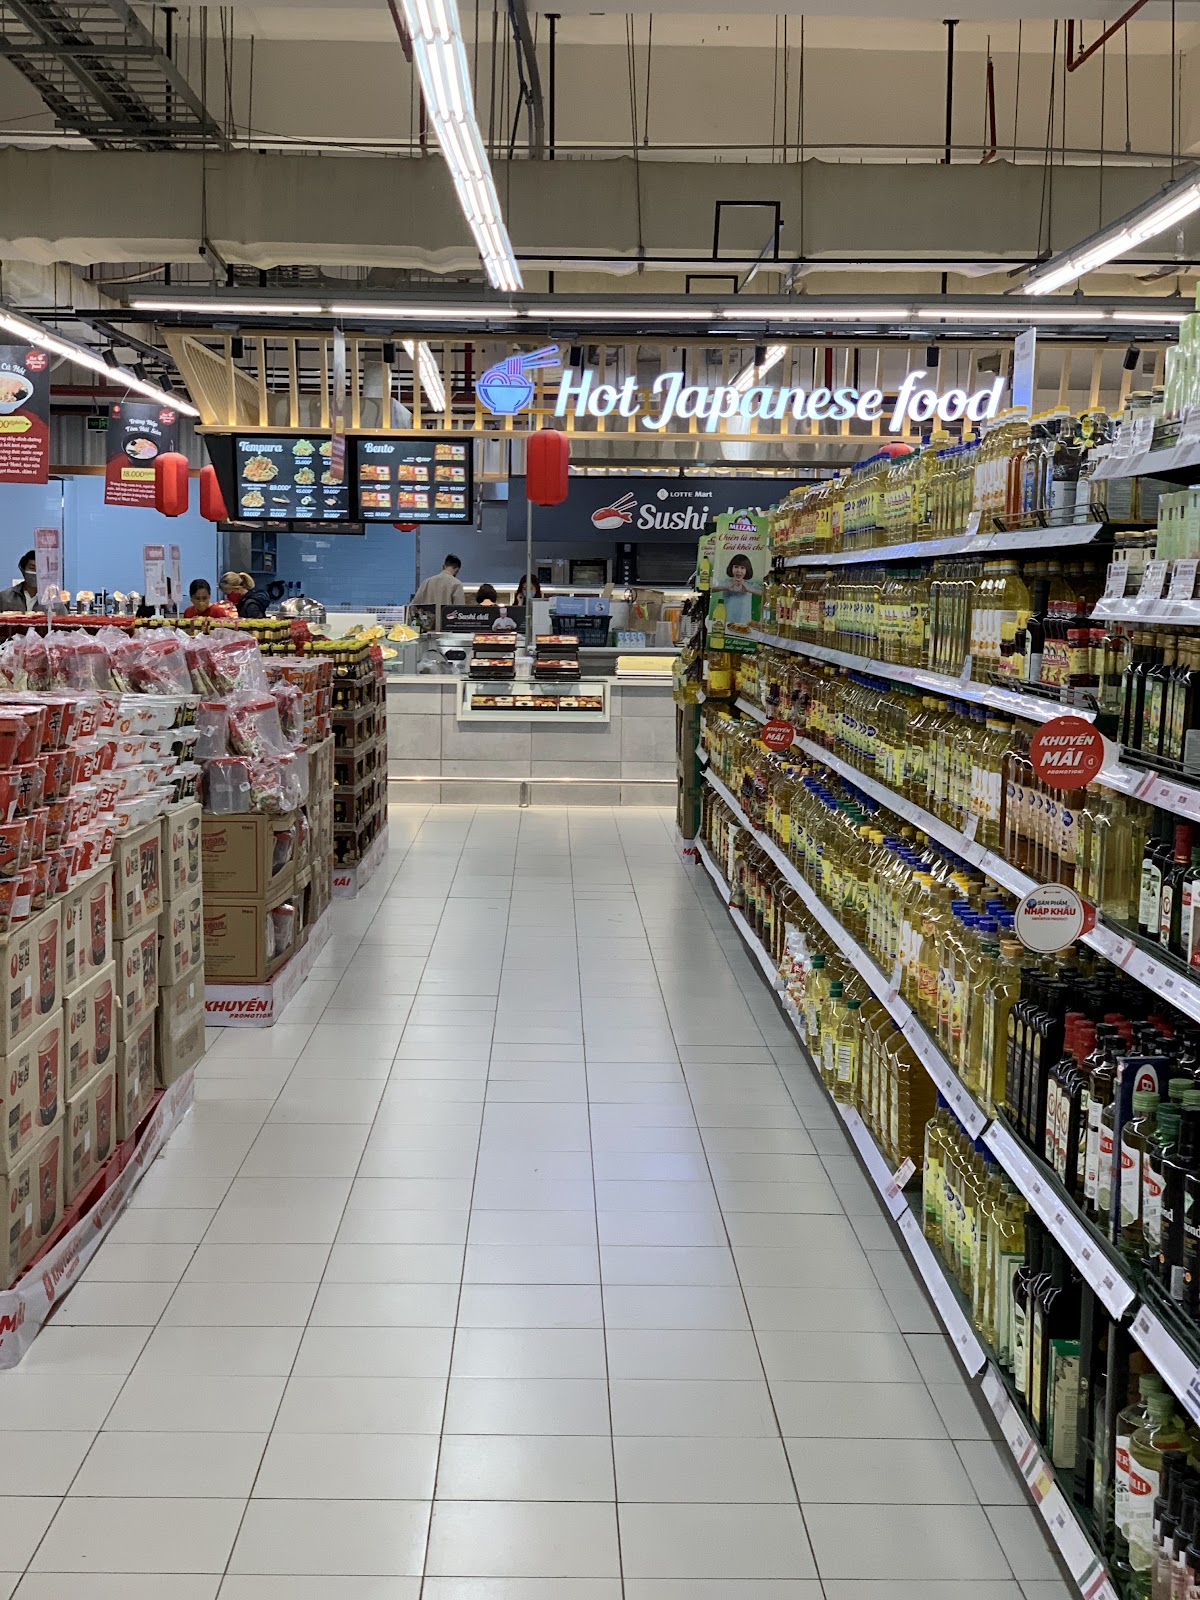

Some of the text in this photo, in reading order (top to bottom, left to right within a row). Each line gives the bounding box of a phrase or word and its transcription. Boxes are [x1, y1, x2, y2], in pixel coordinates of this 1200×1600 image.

[554, 369, 1005, 432] Hot Japanese food
[239, 441, 283, 454] Tempura
[364, 442, 395, 453] Bento
[637, 503, 710, 530] Sushi
[729, 523, 757, 532] MEIZAN
[1039, 733, 1095, 746] KHUYẾN
[1040, 748, 1083, 766] MÃI
[204, 997, 267, 1011] KHUYẾN
